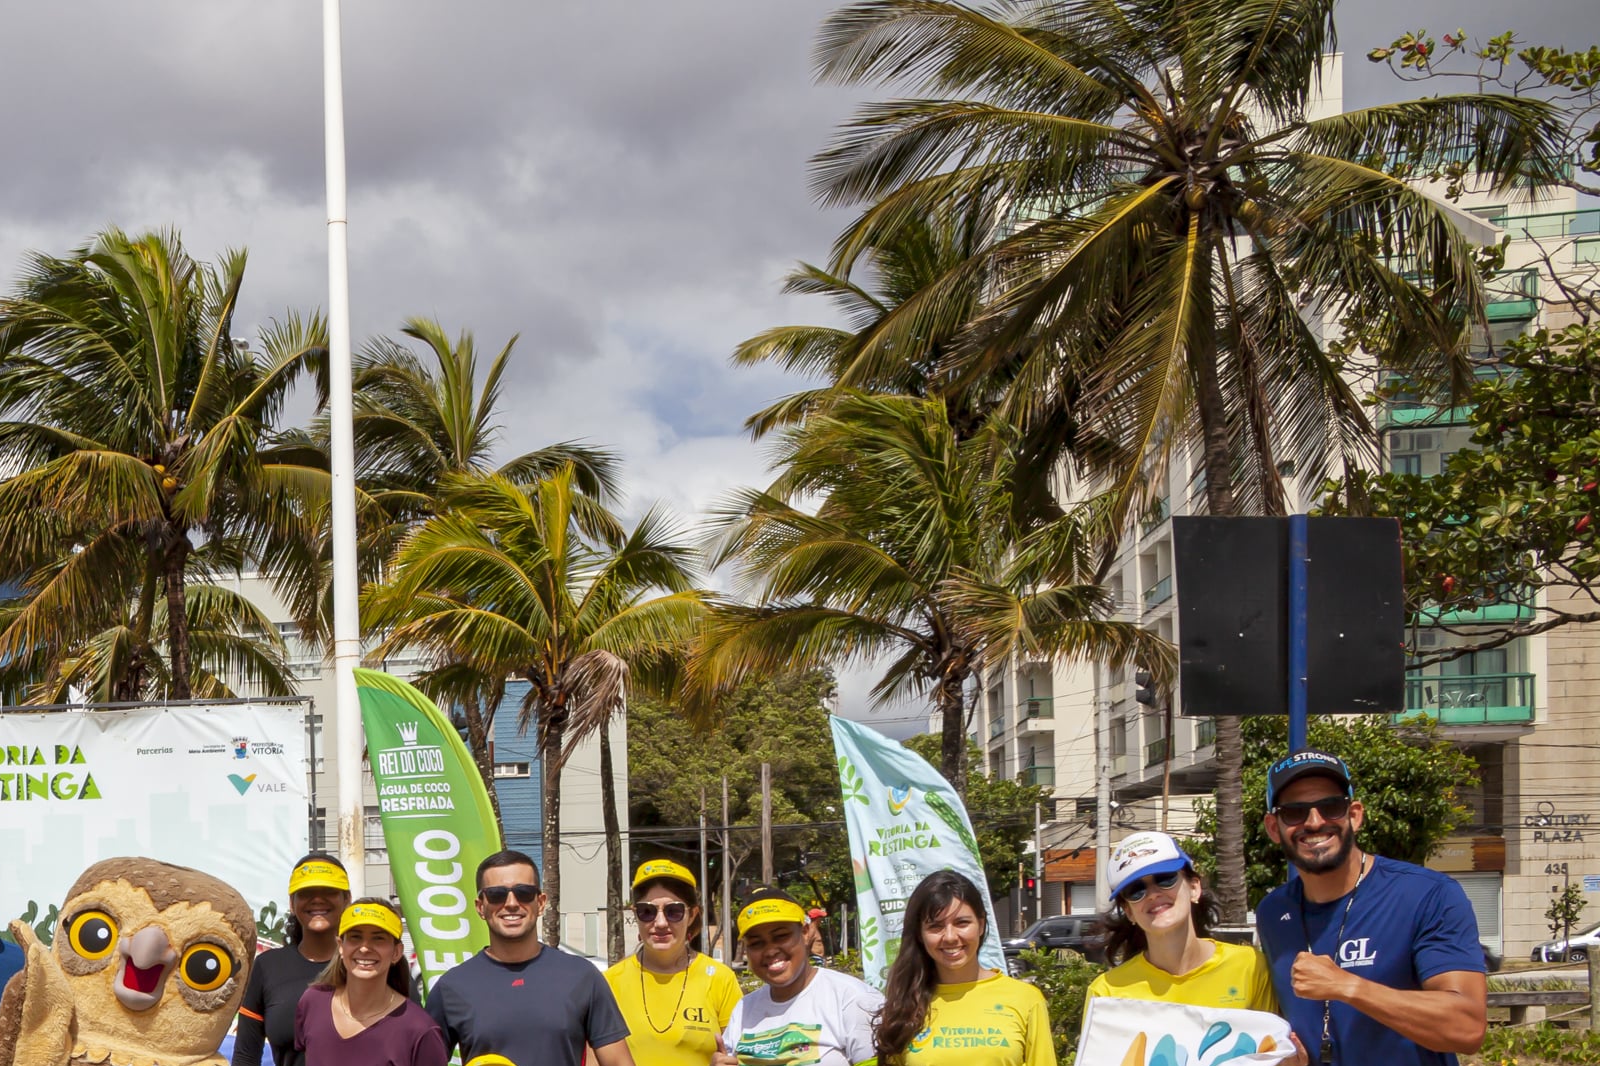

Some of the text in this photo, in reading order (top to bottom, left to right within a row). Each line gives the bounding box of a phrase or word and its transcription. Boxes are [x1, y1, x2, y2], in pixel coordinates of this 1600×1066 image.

[55, 744, 87, 765] DA
[136, 747, 173, 756] Parcerias
[1294, 752, 1338, 765] STRONG
[379, 749, 444, 775] REI DO COCO
[257, 783, 286, 792] VALE
[380, 783, 451, 796] ÁGUA DE COCO
[381, 796, 455, 812] RESFRIADA
[1534, 831, 1583, 843] PLAZA
[868, 834, 941, 857] RESTINGA
[1544, 863, 1568, 875] 435
[413, 830, 470, 940] COCO
[1339, 937, 1377, 962] GL
[683, 1007, 710, 1023] GL
[932, 1036, 1011, 1049] RESTINGA
